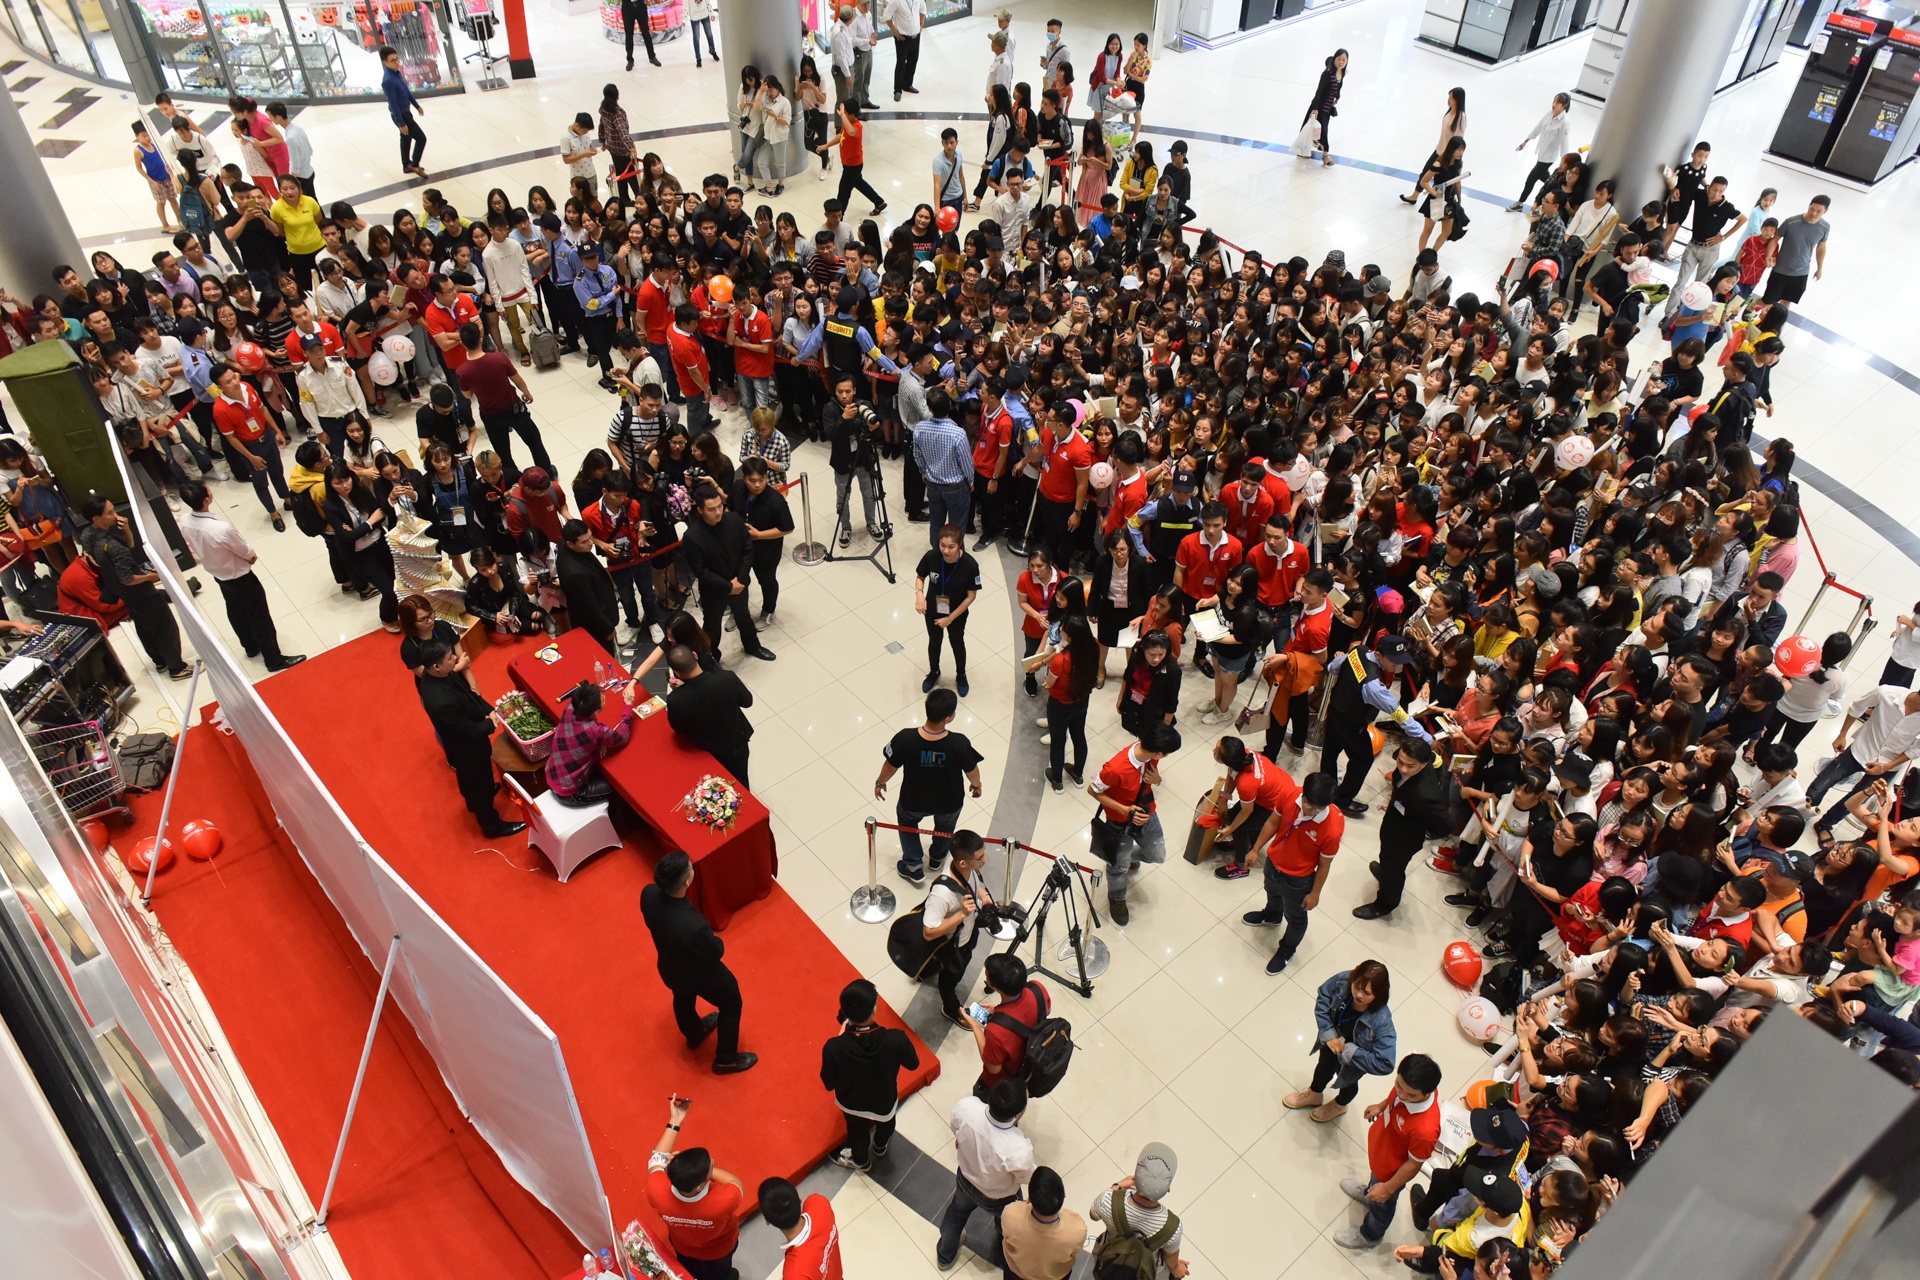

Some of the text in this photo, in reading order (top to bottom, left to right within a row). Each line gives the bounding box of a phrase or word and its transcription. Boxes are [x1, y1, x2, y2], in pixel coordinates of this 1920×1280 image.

[826, 322, 854, 336] SECURITY
[1349, 651, 1367, 681] SECURITY
[1452, 1128, 1464, 1139] THE
